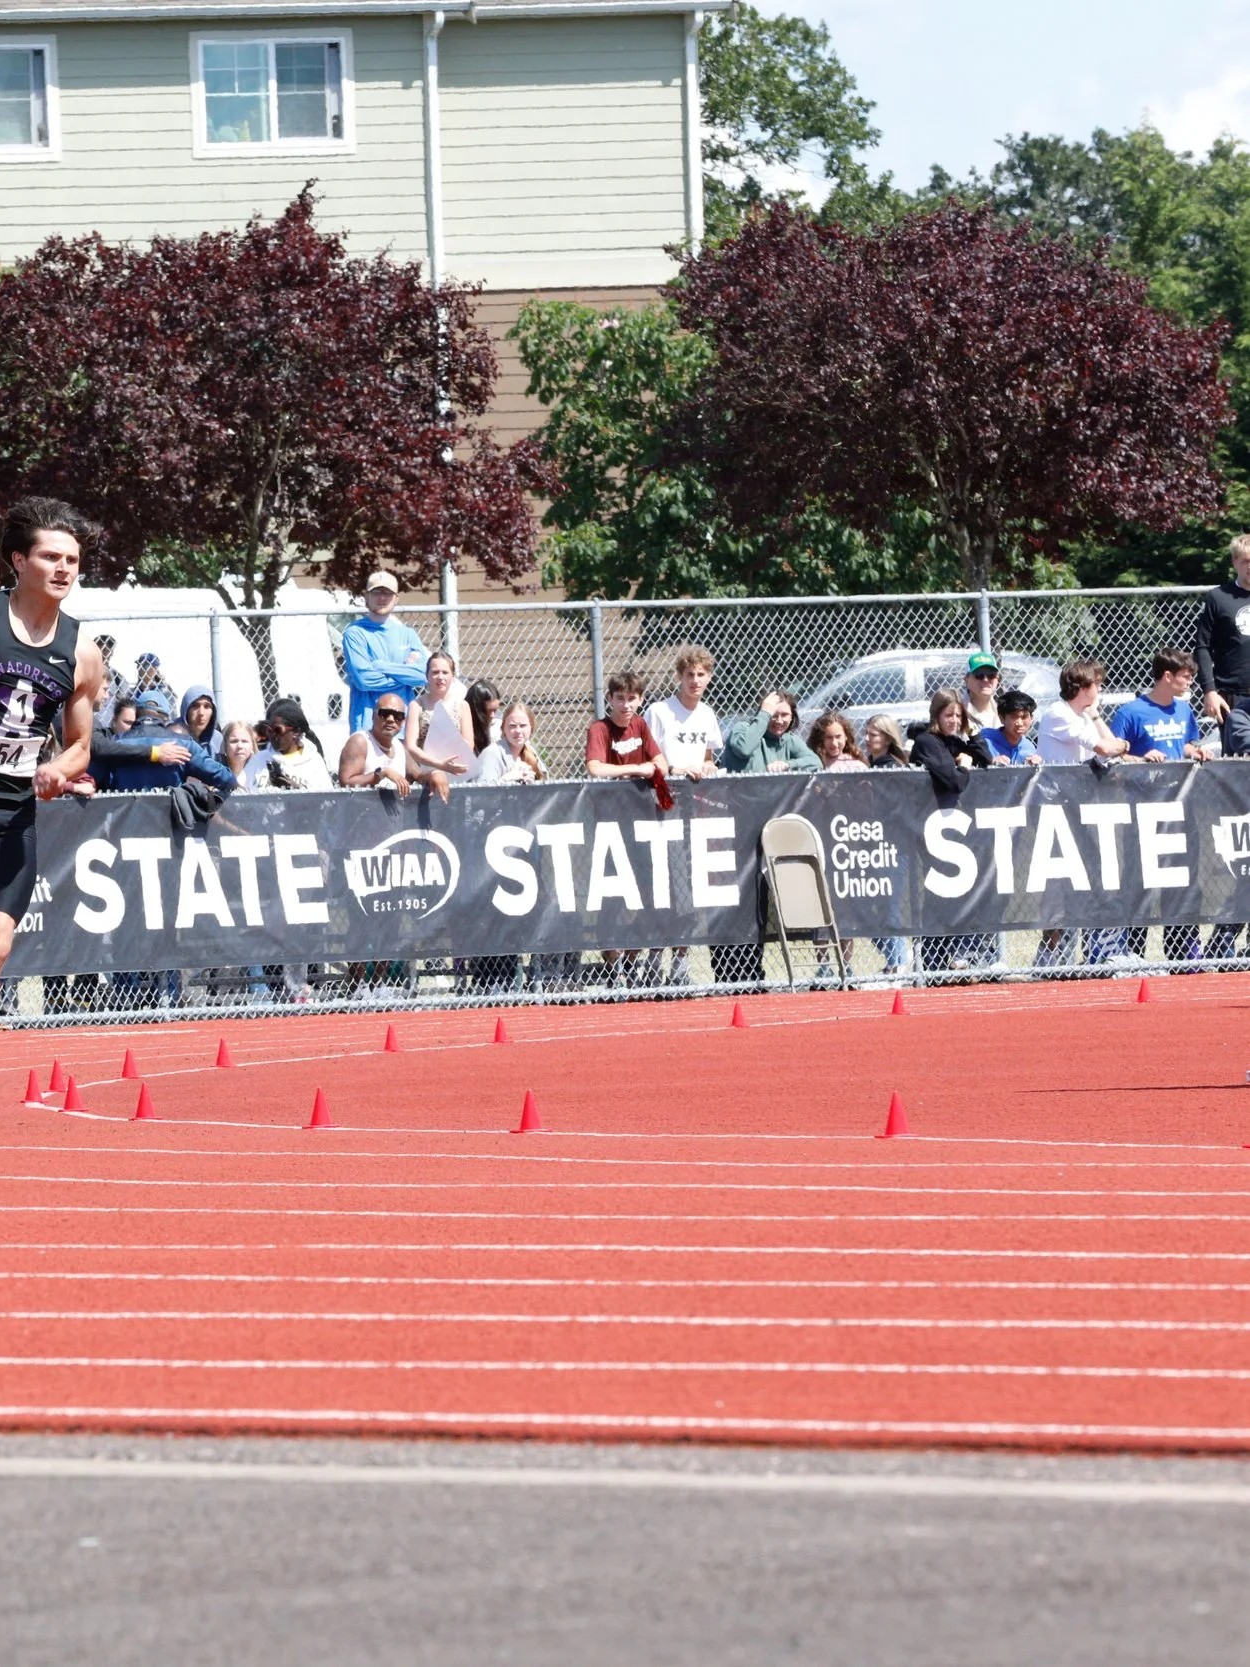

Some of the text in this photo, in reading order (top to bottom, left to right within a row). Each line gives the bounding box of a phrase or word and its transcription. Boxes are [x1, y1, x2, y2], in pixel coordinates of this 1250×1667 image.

[16, 693, 28, 723] 1
[830, 814, 884, 842] Gesa
[484, 816, 740, 917] STATE
[831, 842, 898, 870] Credit
[923, 801, 1190, 899] STATE
[73, 833, 330, 934] STATE
[360, 852, 446, 888] WIAA
[833, 869, 893, 899] Union
